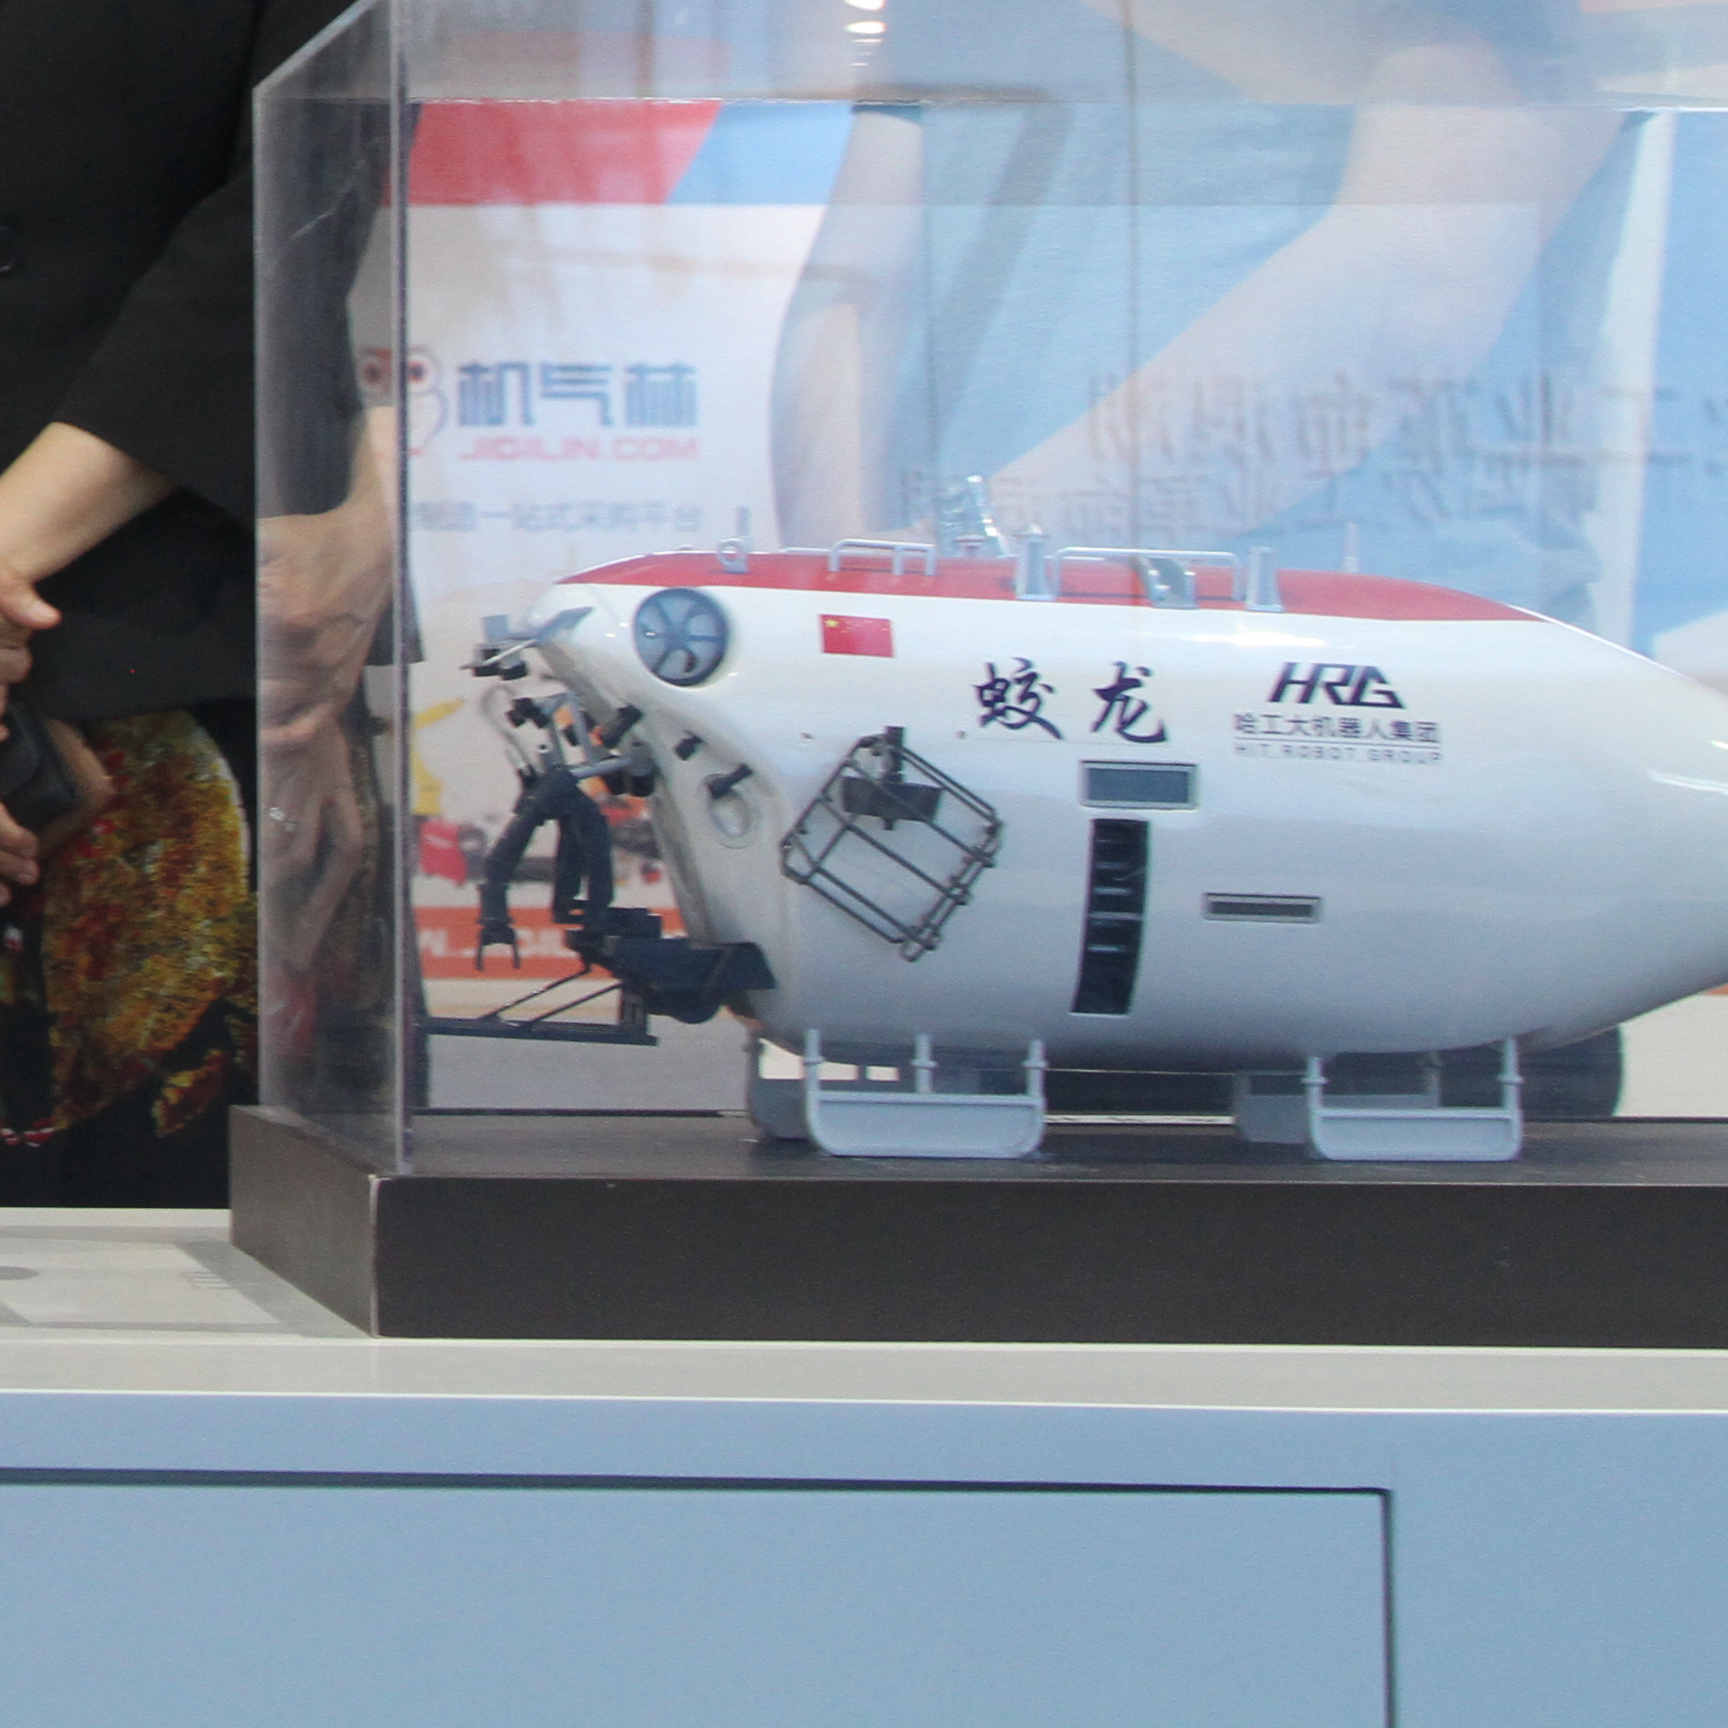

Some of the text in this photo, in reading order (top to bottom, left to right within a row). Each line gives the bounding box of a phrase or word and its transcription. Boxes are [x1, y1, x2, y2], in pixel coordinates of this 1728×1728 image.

[455, 360, 697, 426] 机气林
[972, 656, 1167, 744] 蛟龙
[1268, 662, 1407, 709] HRG
[1233, 712, 1440, 744] 哈工大机器人集团
[1234, 742, 1442, 765] HIT ROBOT GROUP
